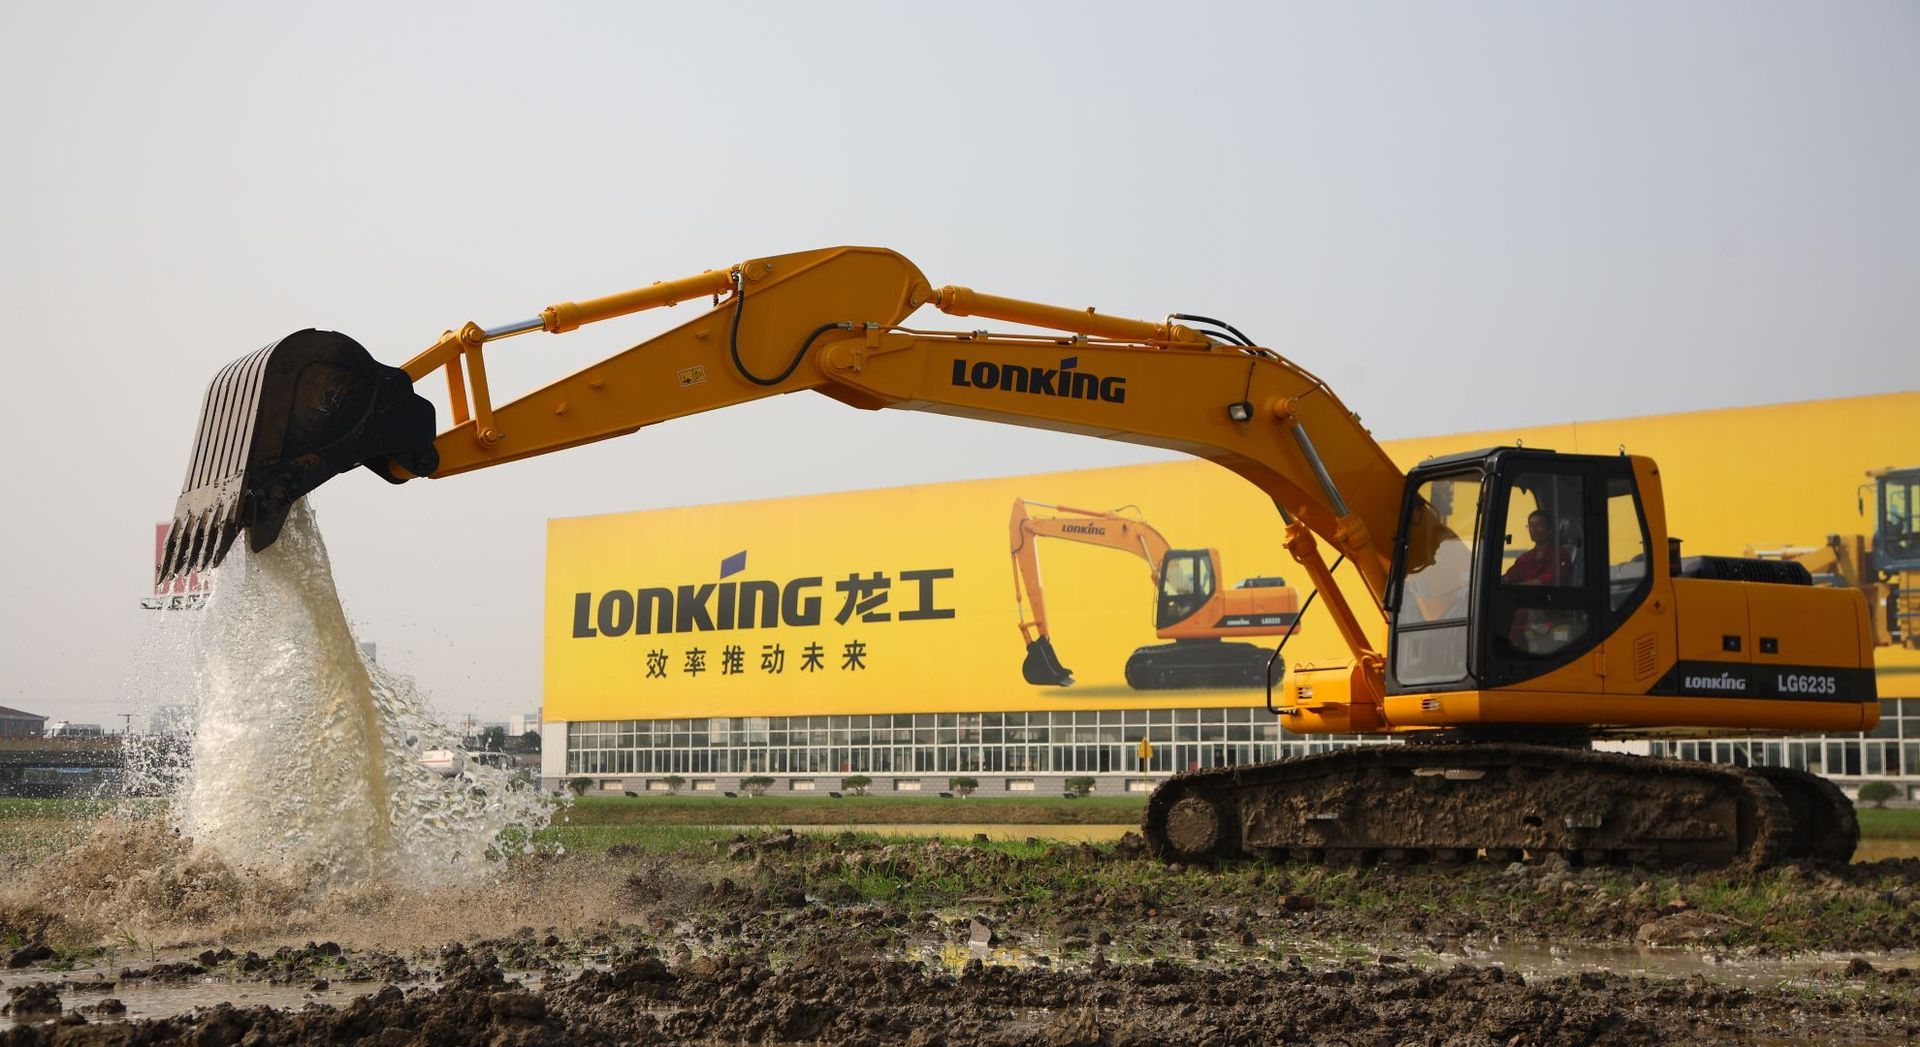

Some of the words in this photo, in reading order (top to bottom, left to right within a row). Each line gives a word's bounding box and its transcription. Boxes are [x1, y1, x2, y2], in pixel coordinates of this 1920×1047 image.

[952, 357, 1126, 403] LONKING
[573, 550, 823, 638] LONKING
[834, 568, 955, 626] 龙工
[646, 640, 867, 679] 效率推动未来
[1777, 674, 1836, 693] LG6235
